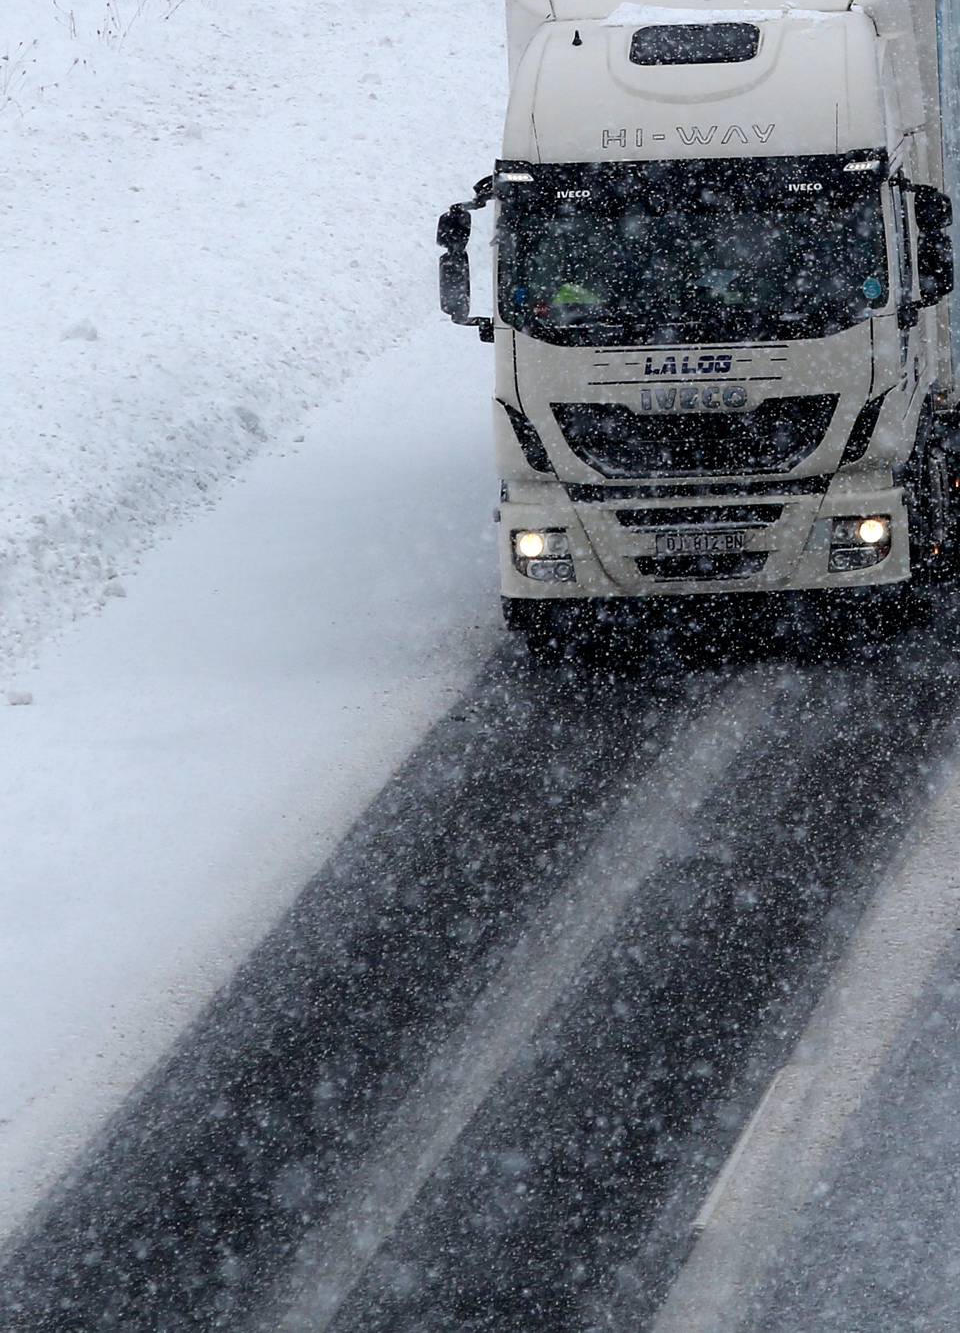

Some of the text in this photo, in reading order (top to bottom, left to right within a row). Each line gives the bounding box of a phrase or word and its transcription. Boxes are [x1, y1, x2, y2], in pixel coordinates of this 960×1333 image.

[602, 124, 776, 148] HI-WAY
[556, 190, 591, 199] IVECO
[787, 183, 823, 191] IVECO
[640, 385, 748, 411] IVECO
